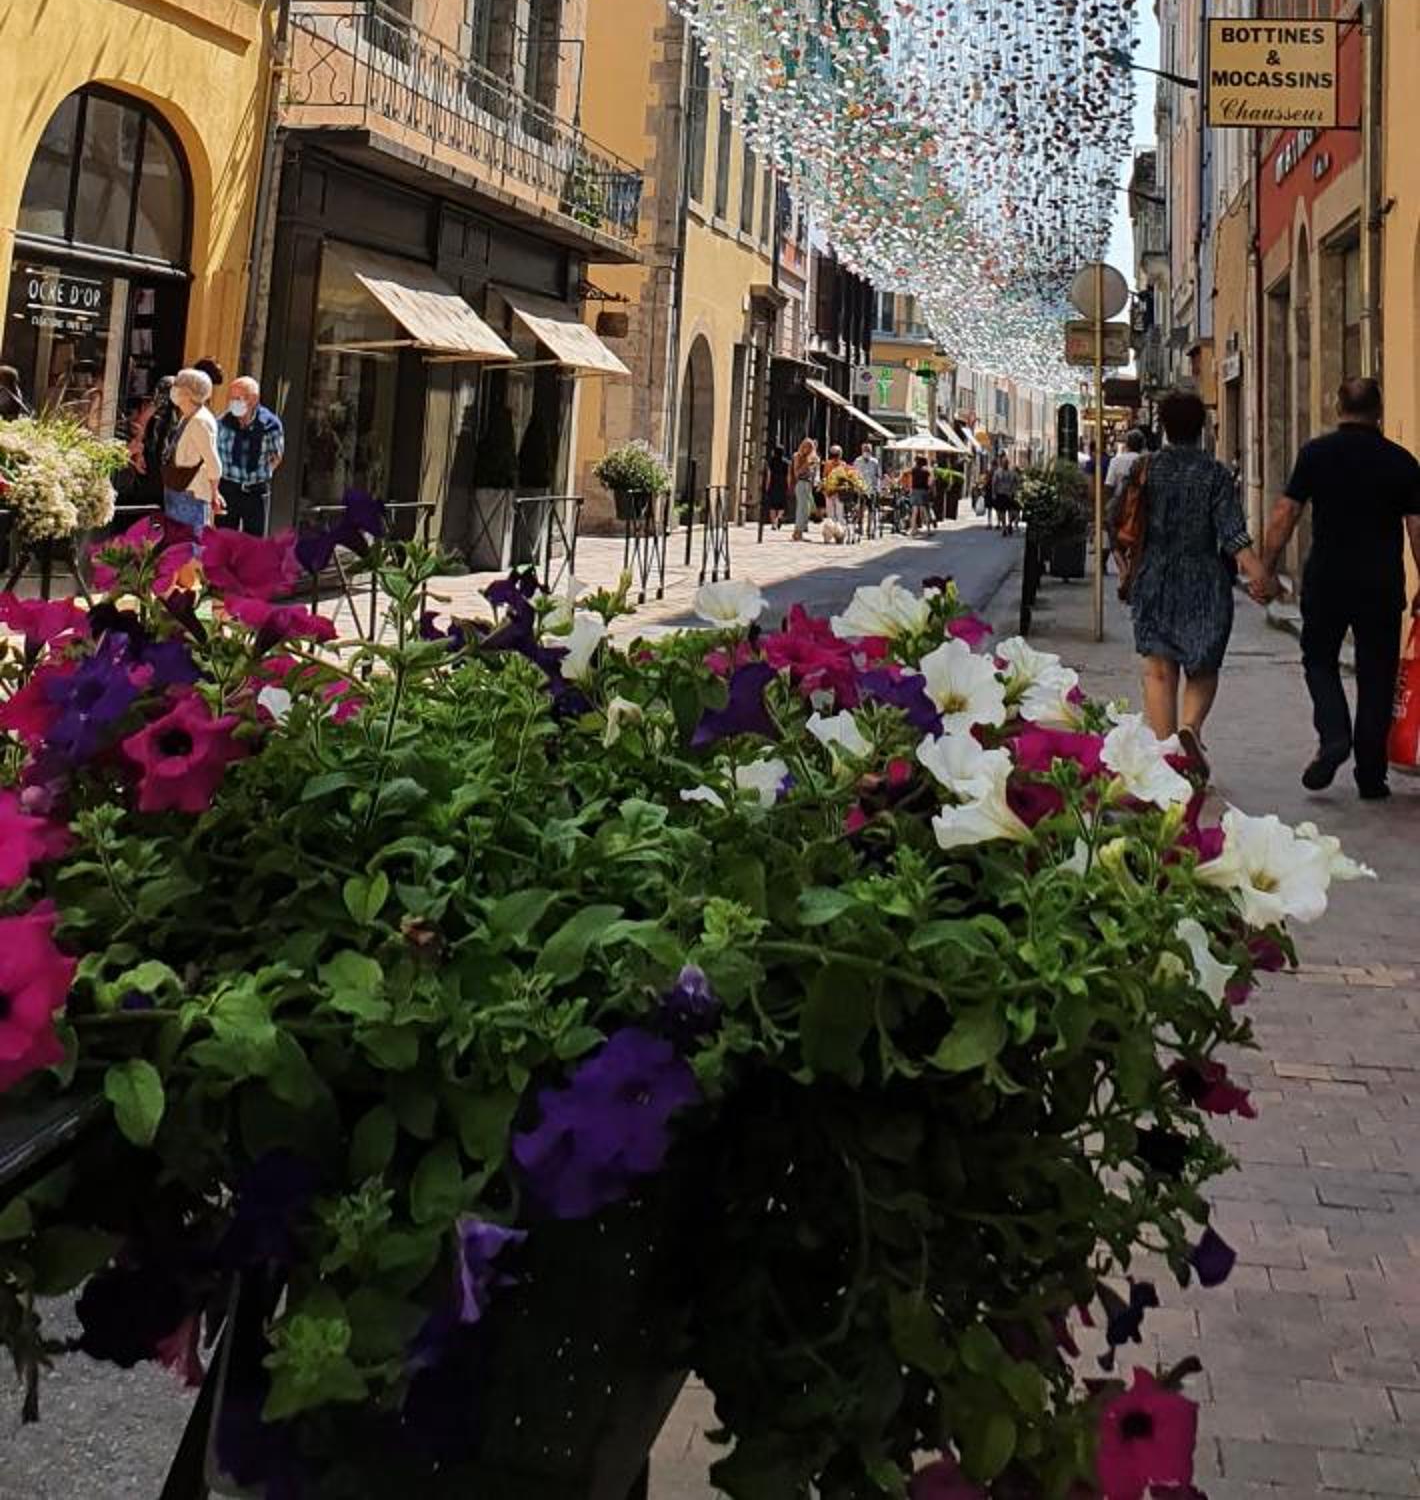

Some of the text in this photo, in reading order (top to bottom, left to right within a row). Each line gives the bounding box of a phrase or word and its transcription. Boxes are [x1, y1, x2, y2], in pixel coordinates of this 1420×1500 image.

[1221, 27, 1324, 45] BOTTINES
[1266, 50, 1281, 66] &
[1212, 71, 1333, 88] MOCASSINS
[1218, 97, 1324, 122] Chausseur
